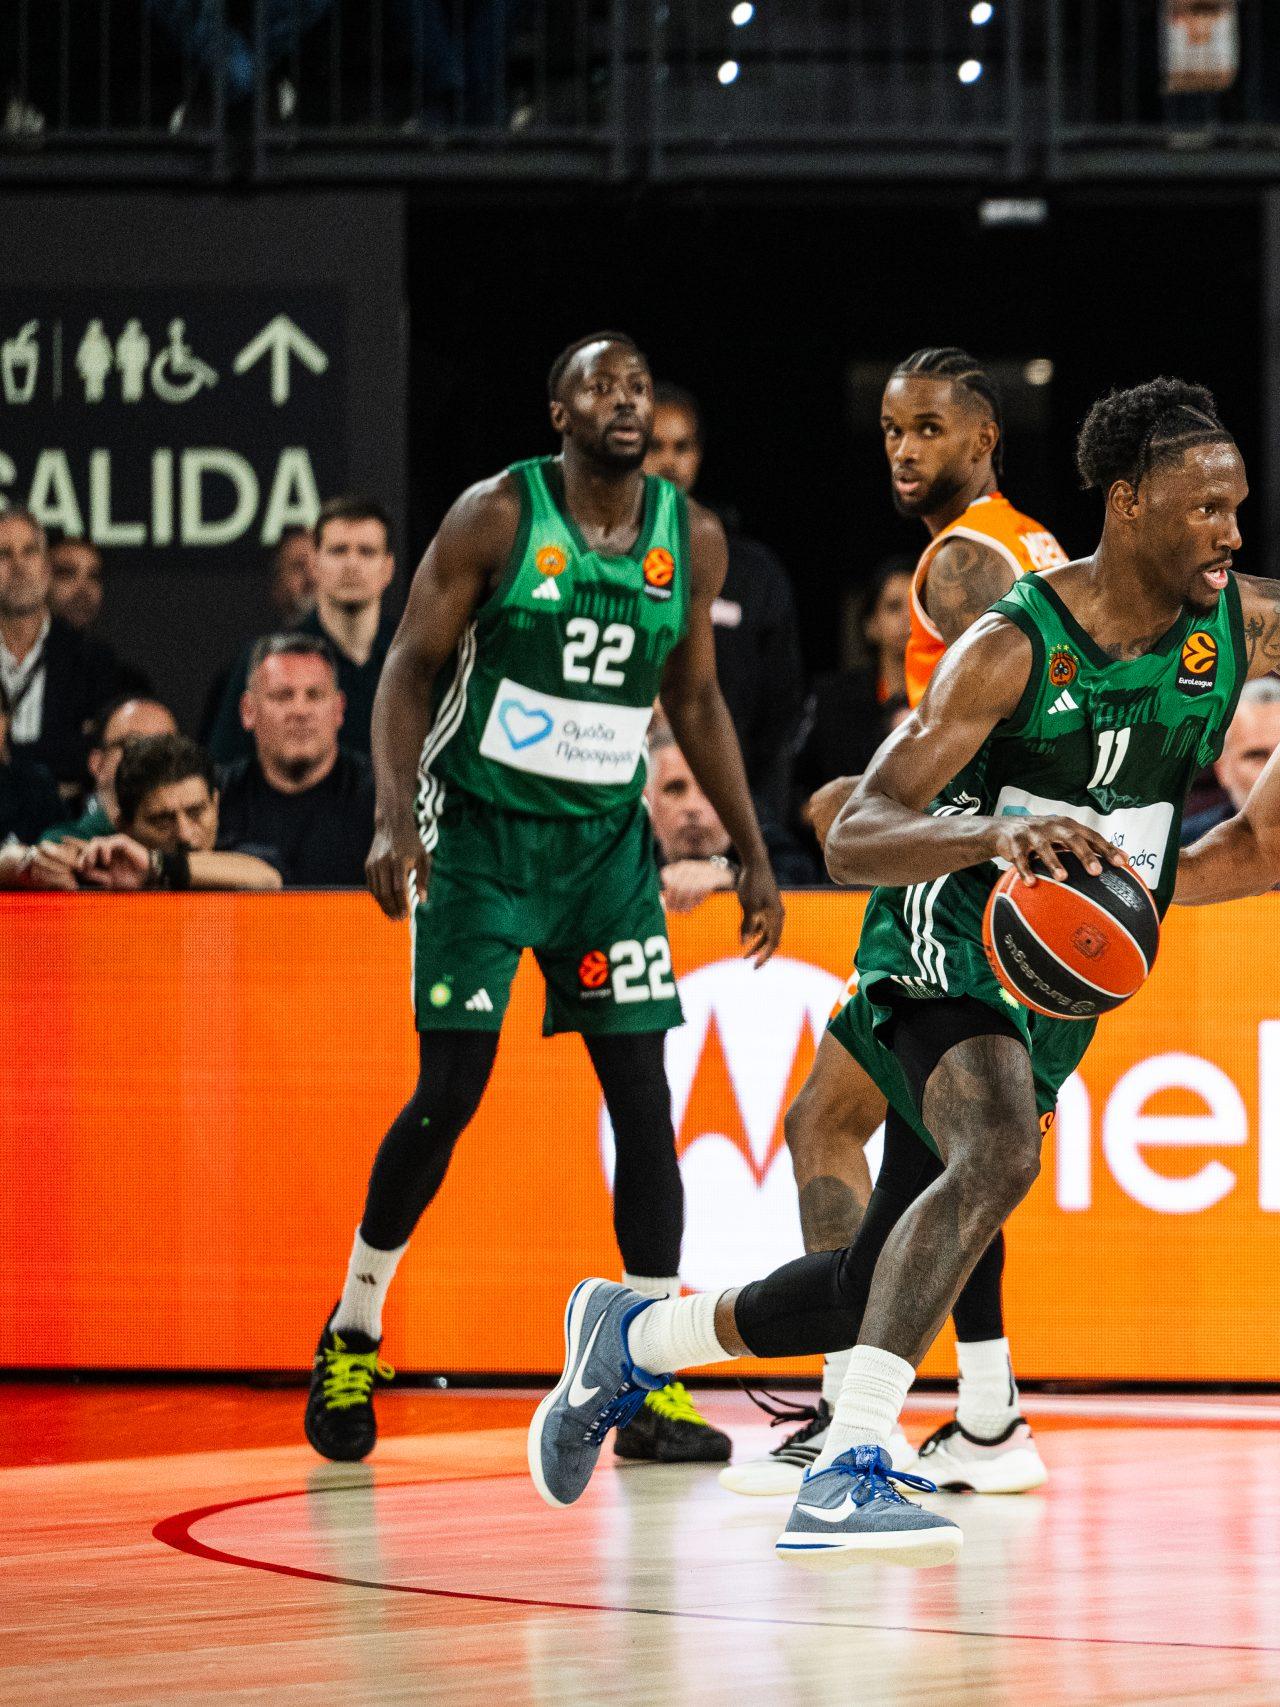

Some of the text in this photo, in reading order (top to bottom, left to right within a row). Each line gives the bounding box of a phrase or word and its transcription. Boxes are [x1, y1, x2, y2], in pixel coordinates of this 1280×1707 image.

[0, 447, 321, 547] ALIDA
[562, 617, 636, 687] 22
[1178, 677, 1213, 688] EuroLeague
[1086, 727, 1131, 789] 11
[609, 935, 677, 1004] 22
[1004, 933, 1073, 1006] EuroLeague
